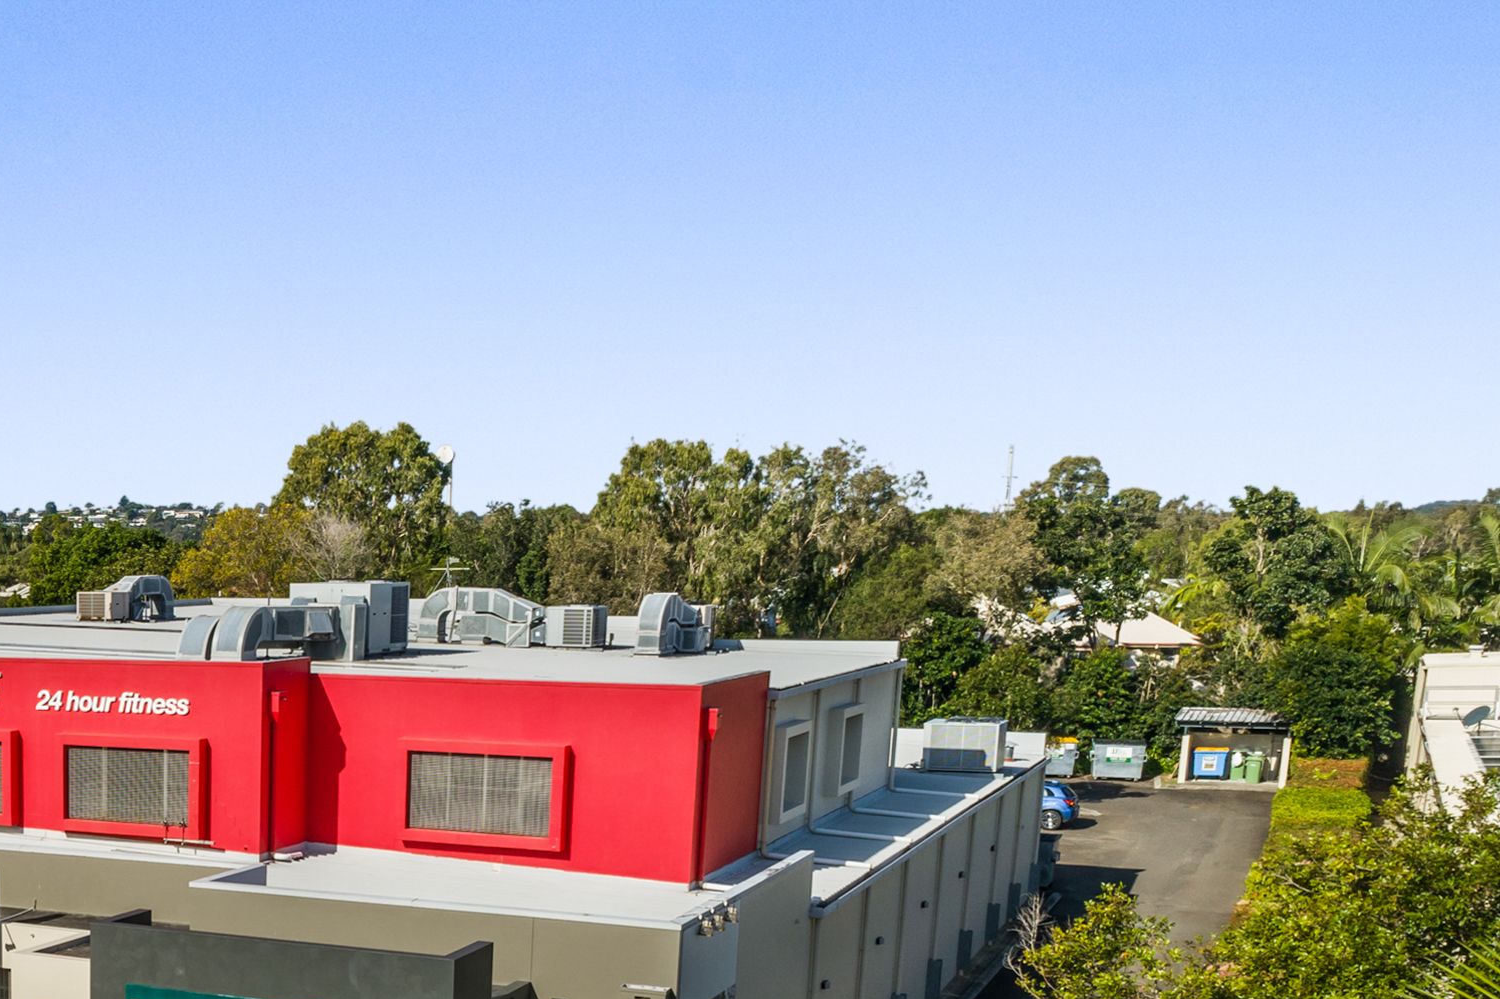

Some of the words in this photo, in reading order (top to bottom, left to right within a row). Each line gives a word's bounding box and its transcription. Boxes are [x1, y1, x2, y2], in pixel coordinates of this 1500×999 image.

[35, 690, 62, 711] 24
[65, 692, 117, 714] hour
[117, 692, 190, 716] fitness
